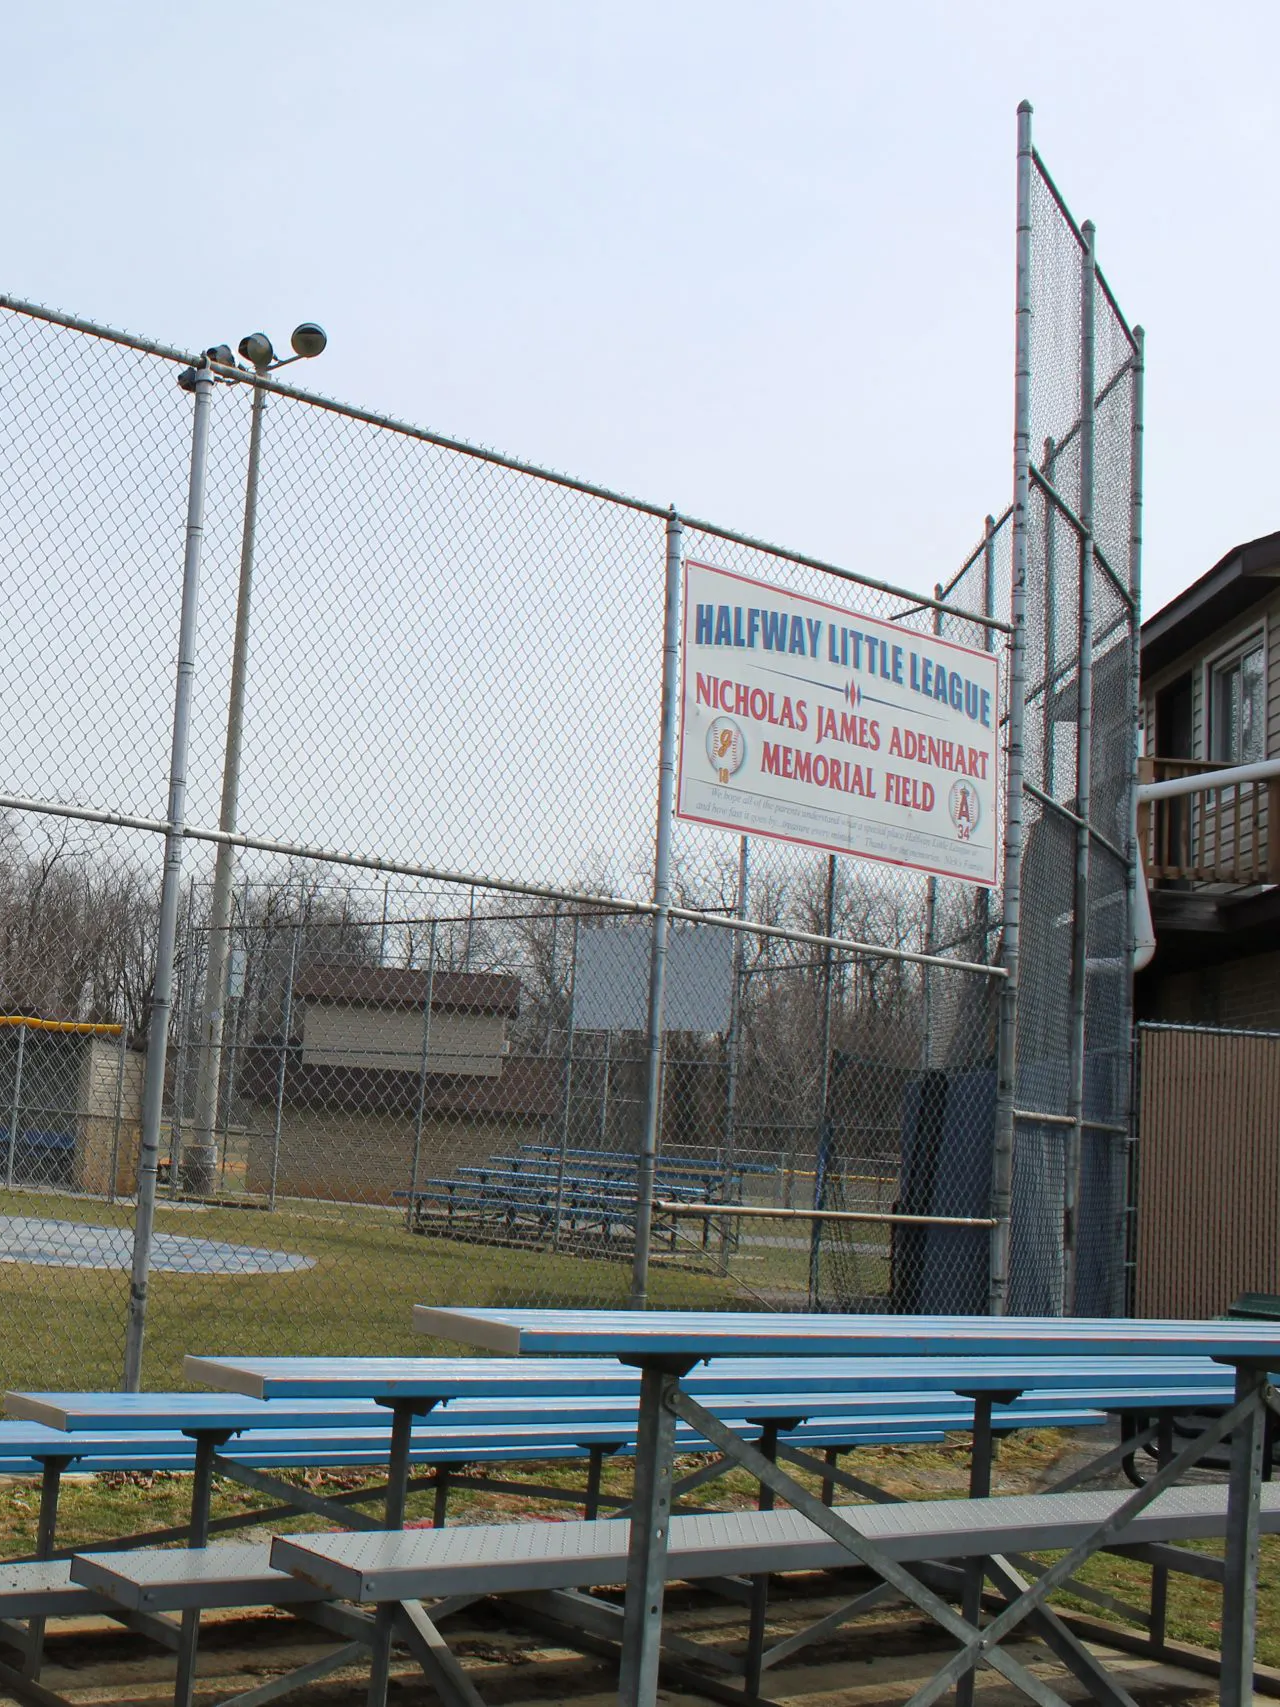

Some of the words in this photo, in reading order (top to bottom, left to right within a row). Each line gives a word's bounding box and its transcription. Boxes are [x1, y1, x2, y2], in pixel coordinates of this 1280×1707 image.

[695, 604, 822, 658] HALFWAY
[828, 624, 903, 685] LITTLE
[910, 652, 990, 728] LEAGUE
[696, 672, 808, 732] NICHOLAS
[816, 705, 880, 751] JAMES
[888, 726, 989, 780] ADENHART
[760, 740, 876, 799] MEMORIAL
[885, 772, 935, 812] FIELD
[723, 789, 741, 804] hope
[774, 803, 800, 816] parents
[802, 808, 840, 824] understand
[728, 806, 742, 818] fast
[958, 786, 970, 822] A
[958, 824, 970, 841] 34
